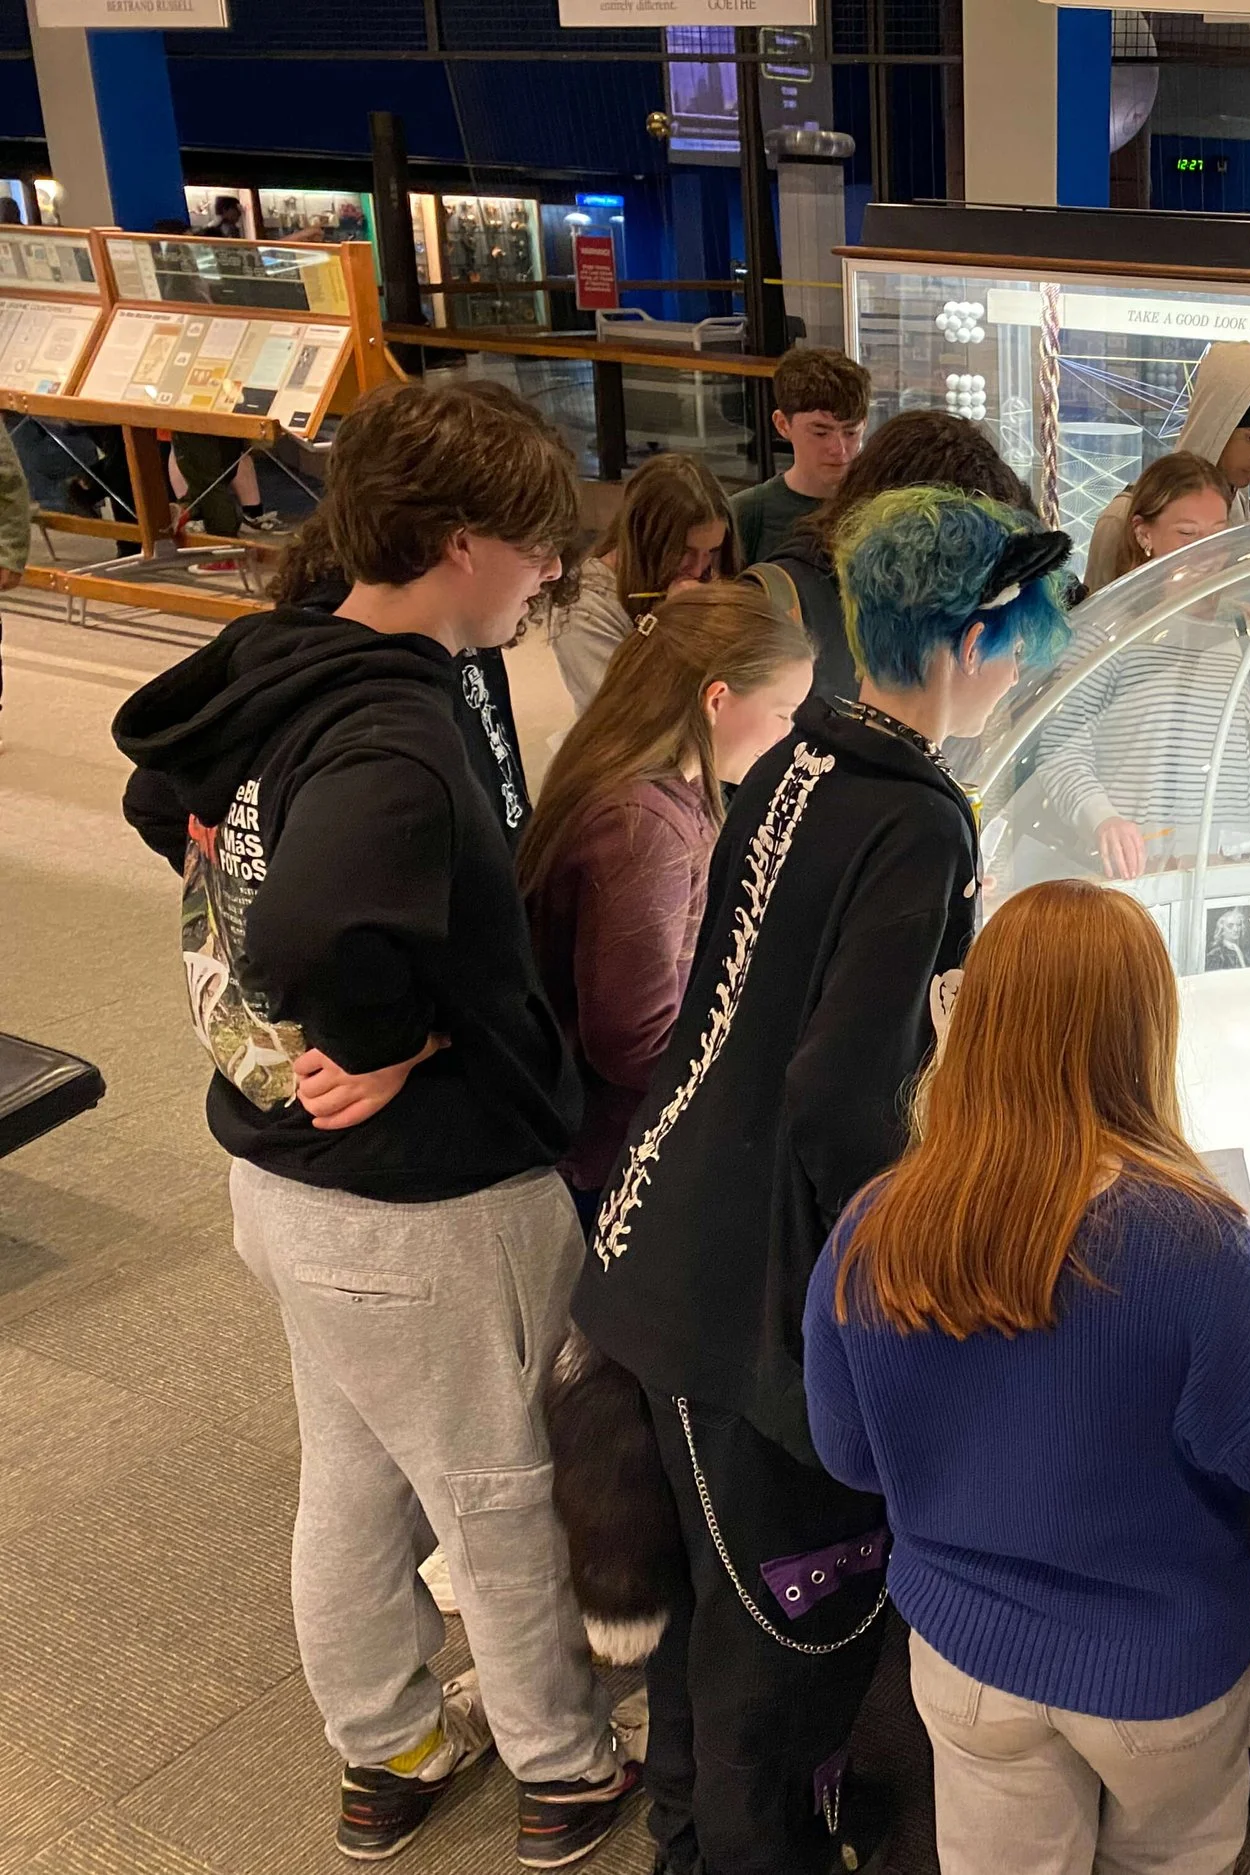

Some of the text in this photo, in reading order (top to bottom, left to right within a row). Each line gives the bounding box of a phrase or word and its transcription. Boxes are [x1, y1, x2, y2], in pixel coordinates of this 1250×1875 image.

[107, 0, 194, 11] BERTRAND RUSSELL
[708, 0, 757, 9] GOETHE
[1177, 158, 1204, 171] 12:27
[1127, 309, 1160, 324] TAKE
[1163, 312, 1173, 325] A
[1175, 312, 1209, 327] GOOD
[1213, 315, 1247, 330] LOOK
[236, 777, 262, 806] eBÍ
[227, 801, 260, 831] RAR
